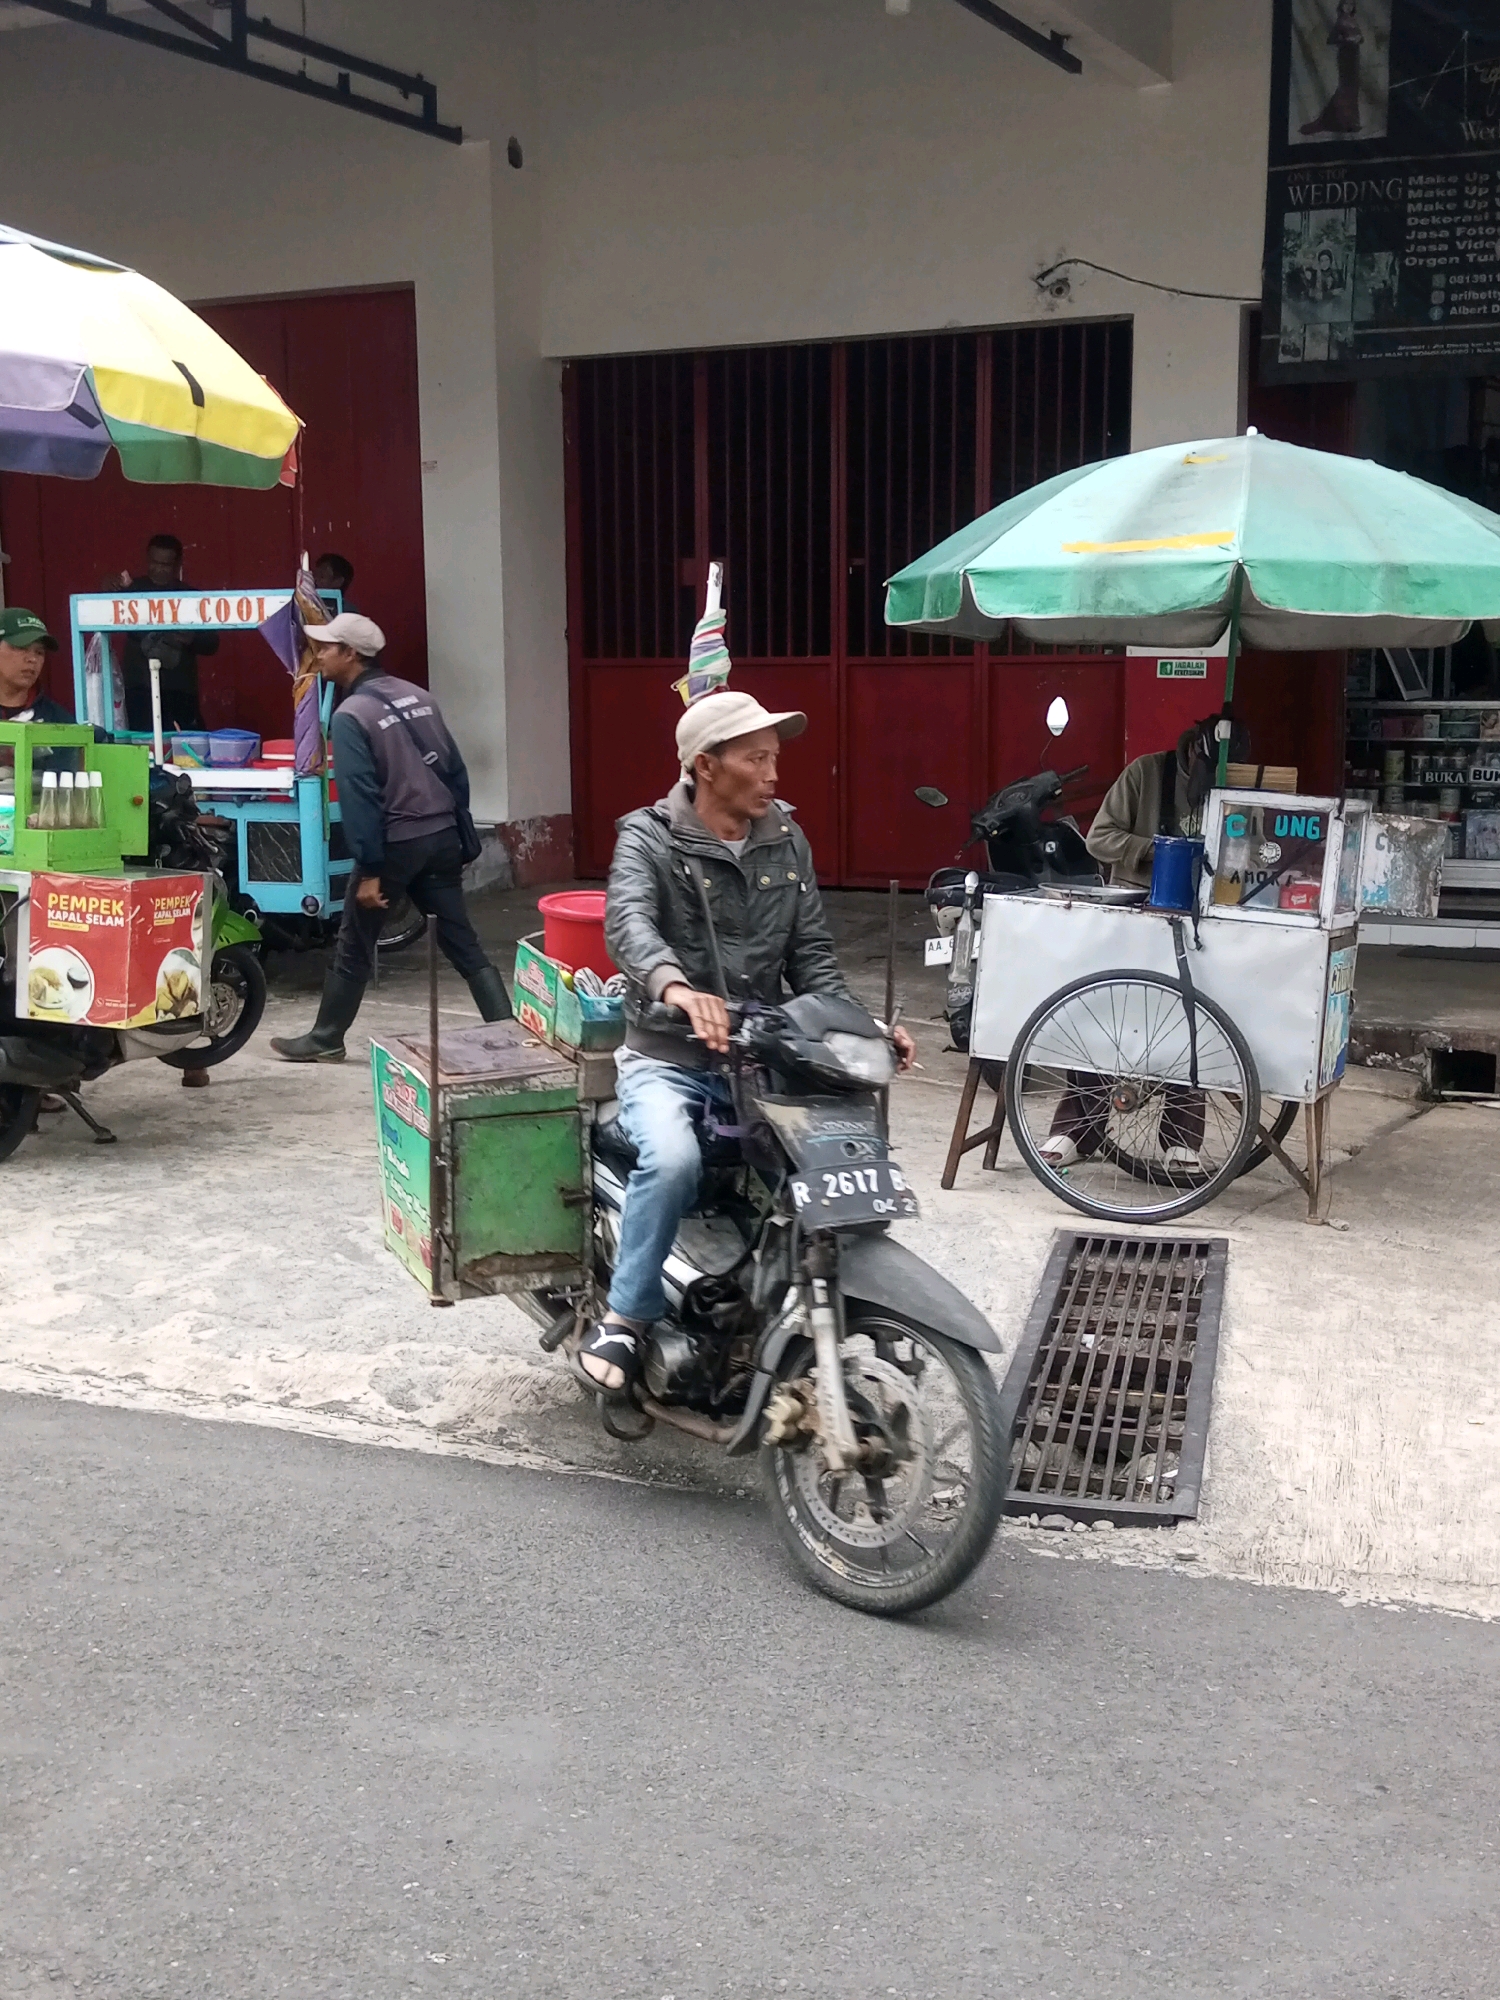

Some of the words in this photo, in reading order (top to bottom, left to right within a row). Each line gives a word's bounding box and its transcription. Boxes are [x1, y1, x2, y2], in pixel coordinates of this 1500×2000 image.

[1407, 174, 1459, 186] Make
[1464, 171, 1490, 185] Up
[1287, 177, 1403, 206] WEDDING
[1407, 187, 1458, 199] Make
[1464, 185, 1490, 197] Up
[1406, 201, 1457, 213] Make
[1463, 199, 1489, 211] Up
[1406, 211, 1490, 226] Dekorasi
[1405, 229, 1450, 240] Jasa
[1405, 243, 1449, 253] Jasa
[1455, 239, 1500, 250] Vide
[1449, 304, 1488, 315] Albert
[112, 600, 139, 625] ES
[149, 598, 182, 624] MY
[1424, 771, 1465, 784] BUKA
[47, 892, 125, 917] PEMPEK
[155, 895, 191, 911] PEMPEK
[47, 909, 83, 924] KAPAL
[85, 913, 125, 928] SELAM
[154, 910, 173, 920] KAPAL
[172, 907, 192, 919] SELAM
[927, 940, 943, 952] AA
[792, 1181, 813, 1208] R
[821, 1168, 880, 1198] 2617
[888, 1168, 915, 1192] B
